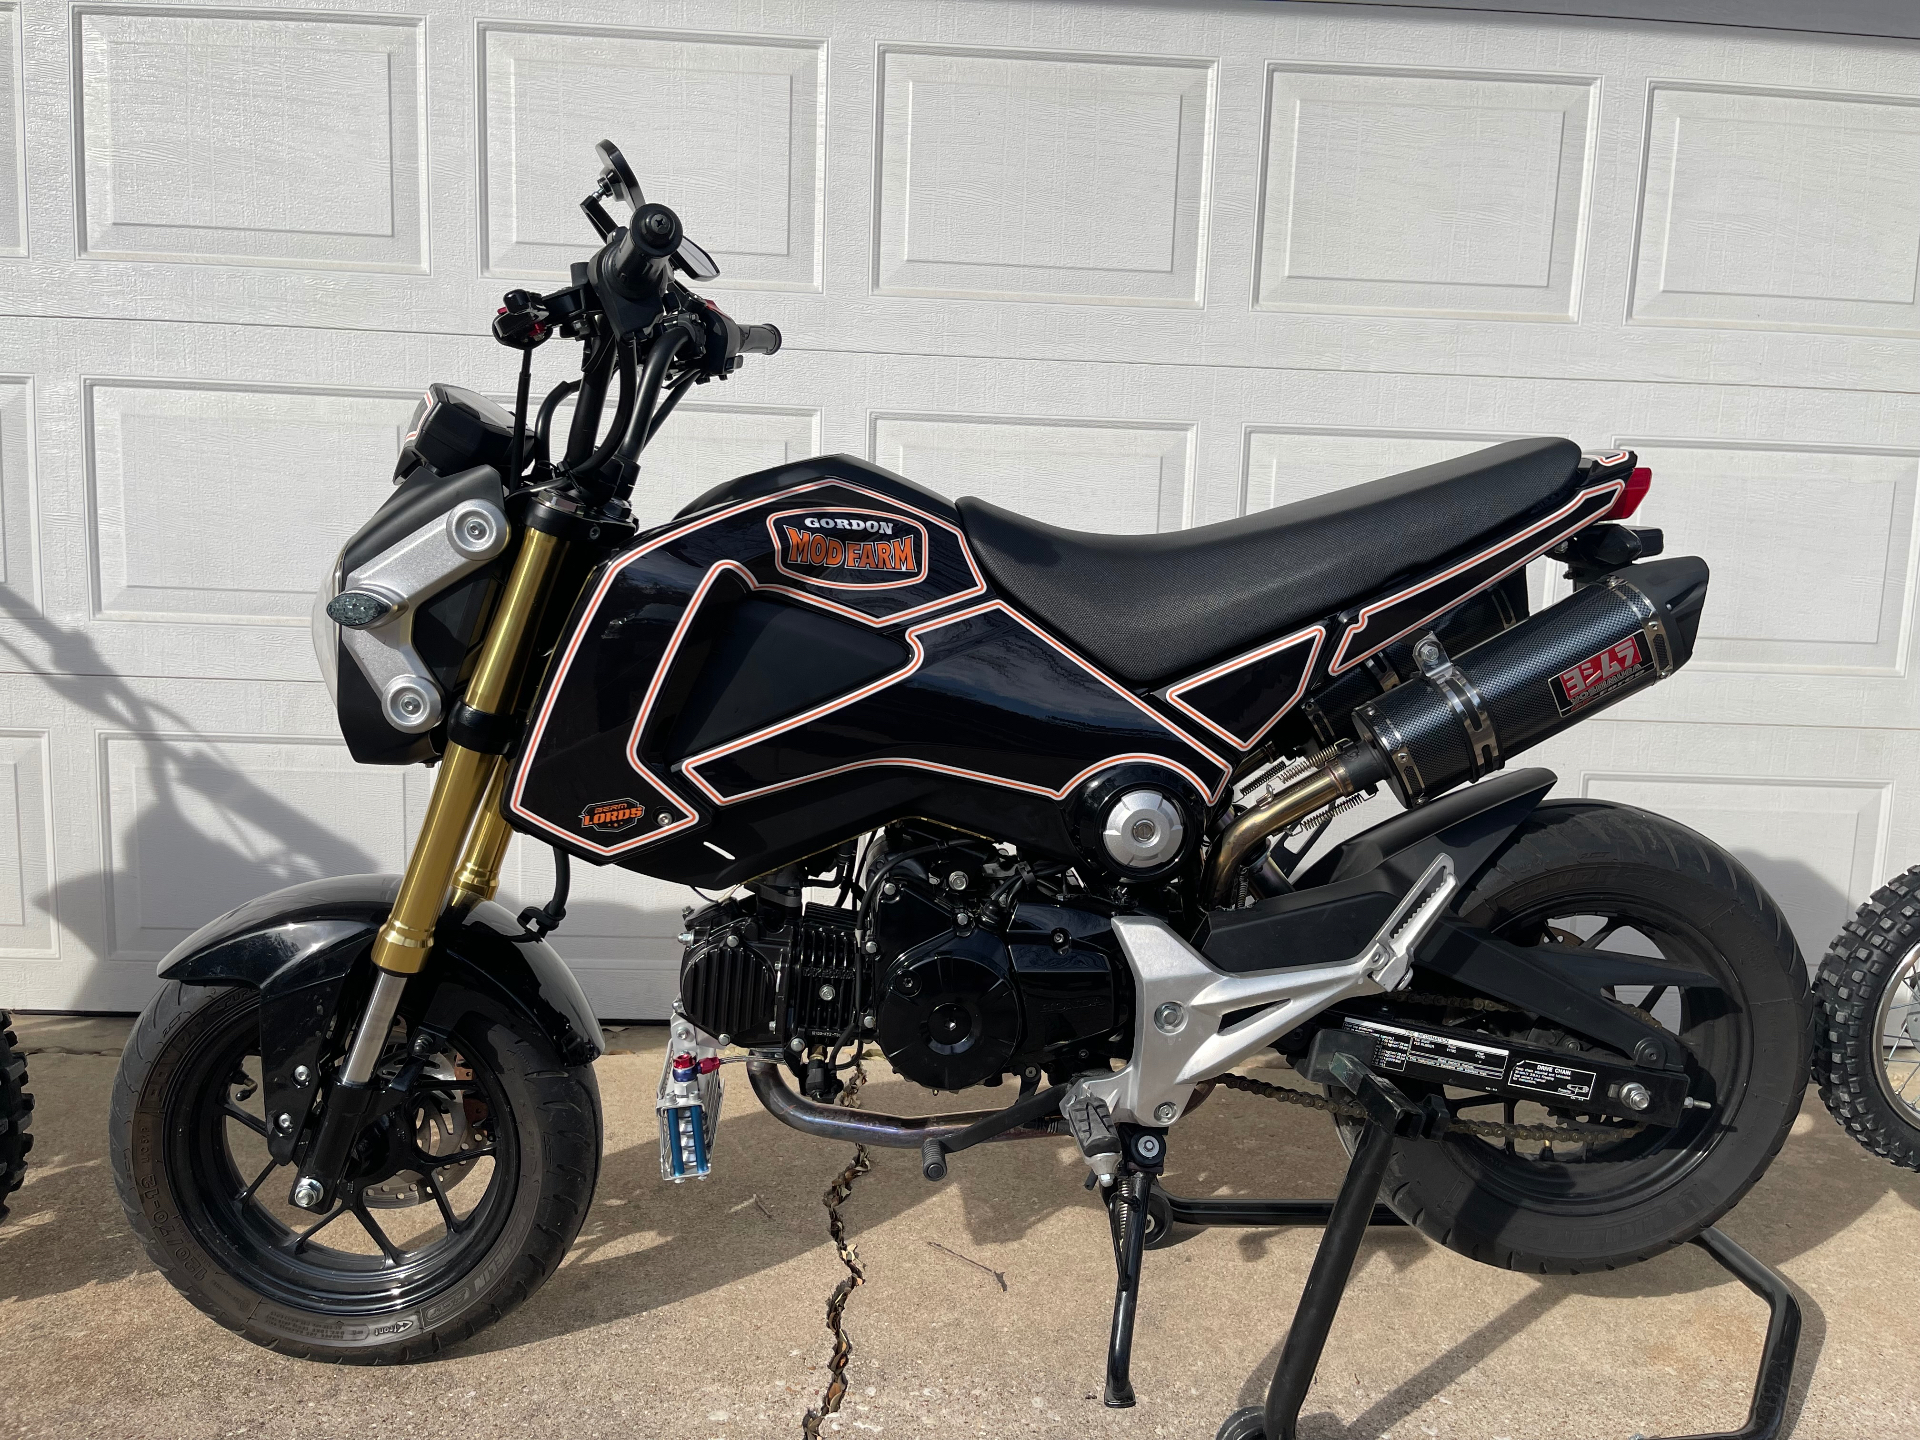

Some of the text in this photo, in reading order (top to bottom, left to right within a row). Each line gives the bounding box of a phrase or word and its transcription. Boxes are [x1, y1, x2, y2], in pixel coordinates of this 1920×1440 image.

[804, 517, 894, 535] GORDON
[784, 525, 917, 573] MOD FARM
[1563, 639, 1635, 695] ヨシムラ
[1570, 662, 1642, 705] YOSHIMURA
[584, 808, 643, 826] LORDS
[595, 803, 627, 813] BERM
[1040, 996, 1106, 1013] HONDA
[1536, 1064, 1553, 1073] DRIVE
[1554, 1068, 1572, 1076] CHAIN
[141, 1173, 208, 1282] 120/70-12
[473, 1213, 529, 1293] MICHELIN
[374, 1324, 398, 1337] front
